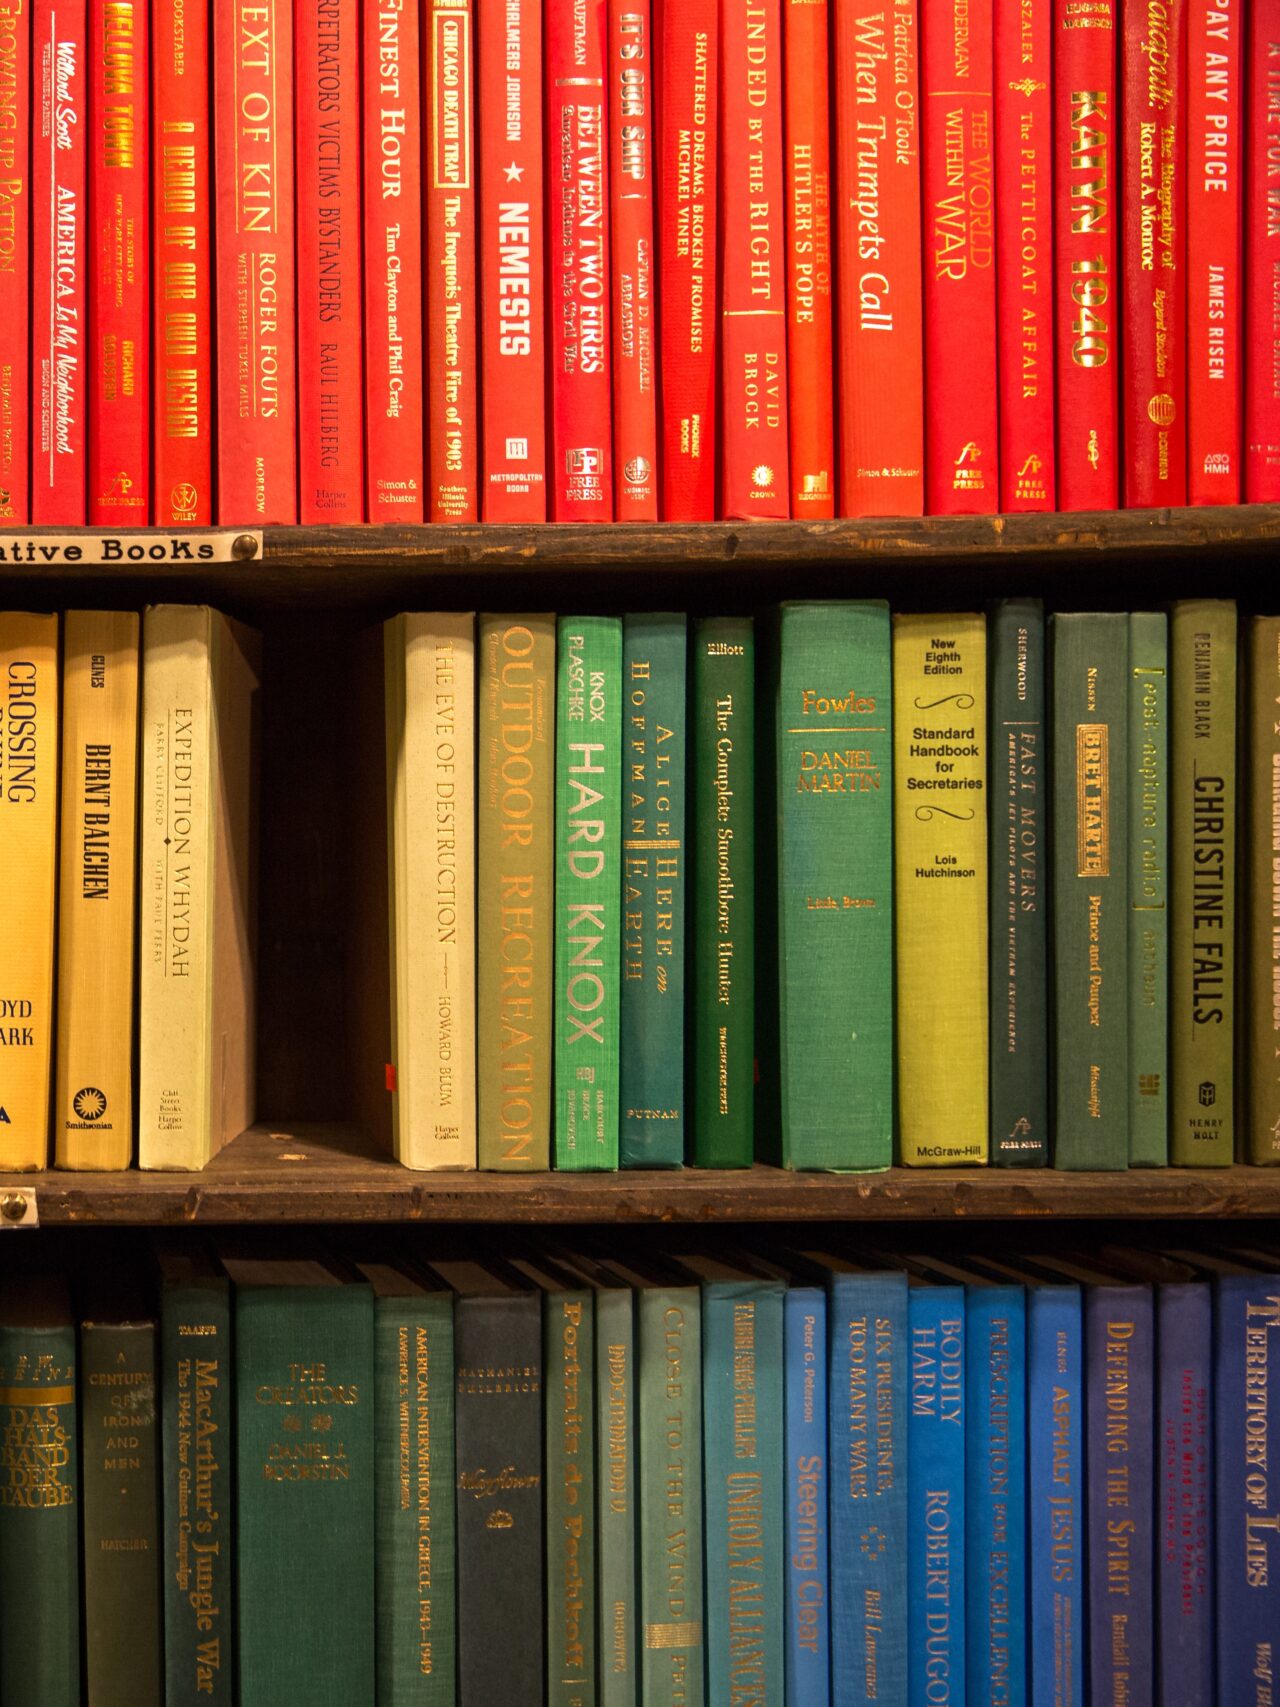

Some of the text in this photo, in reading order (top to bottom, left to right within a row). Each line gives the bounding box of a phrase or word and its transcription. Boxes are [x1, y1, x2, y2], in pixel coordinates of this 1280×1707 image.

[442, 21, 460, 184] CHICAGO DEATH TRAP
[893, 13, 915, 164] Patricia O'Toole
[1204, 53, 1228, 192] ANY PRICE
[677, 130, 690, 257] MICHAEL VINER
[691, 32, 707, 353] SHATTERED DREAMS, BROKEN PROMISES
[794, 144, 813, 323] HITLER'S POPE
[851, 12, 892, 331] When Trumpets Call
[1070, 91, 1109, 367] KATYN 1940
[383, 224, 402, 418] Tim Clayton and Phil Craig
[440, 196, 462, 470] The Iroquois Theatre Fire of 1903
[498, 202, 529, 356] NEMESIS
[1208, 264, 1225, 379] JAMES RISEN
[255, 457, 266, 513] MORROW
[100, 538, 215, 560] Books
[568, 636, 584, 721] PLASCHKE
[590, 672, 605, 723] KNOX
[923, 665, 963, 676] Edition
[924, 652, 962, 663] Eighth
[930, 639, 957, 651] New
[1193, 633, 1213, 739] BENJAMIN BLACK
[7, 661, 38, 803] CROSSING
[716, 695, 733, 730] The
[910, 745, 980, 757] Handbook
[912, 728, 975, 740] Standard
[935, 761, 955, 773] for
[83, 744, 112, 900] BERNT BALCHEN
[171, 708, 193, 978] EXPEDITION WHYDAH
[435, 640, 457, 944] THE EVE OF DESTRUCTION
[714, 738, 734, 822] Complete
[907, 777, 983, 790] Secretaries
[500, 625, 535, 1162] OUTDOOR RECREATION
[565, 742, 605, 1045] HARD KNOX
[915, 868, 975, 879] Hutchinson
[935, 855, 958, 865] Lois
[1193, 777, 1224, 1024] CHRISTINE FALLS
[717, 941, 733, 1005] Hunter
[437, 996, 453, 1107] HOWARD BLUM
[917, 1146, 981, 1157] McGraw-Hill
[849, 1317, 867, 1498] TOO MANY WARS
[874, 1319, 894, 1496] SIX PRESIDENTS,
[912, 1327, 935, 1416] HARM
[939, 1320, 961, 1425] BODILY
[416, 1327, 432, 1593] AMERICAN INTERVENTION IN GREECE,
[190, 1360, 220, 1694] MacArthur's Jungle War
[793, 1455, 823, 1653] Steering Clear
